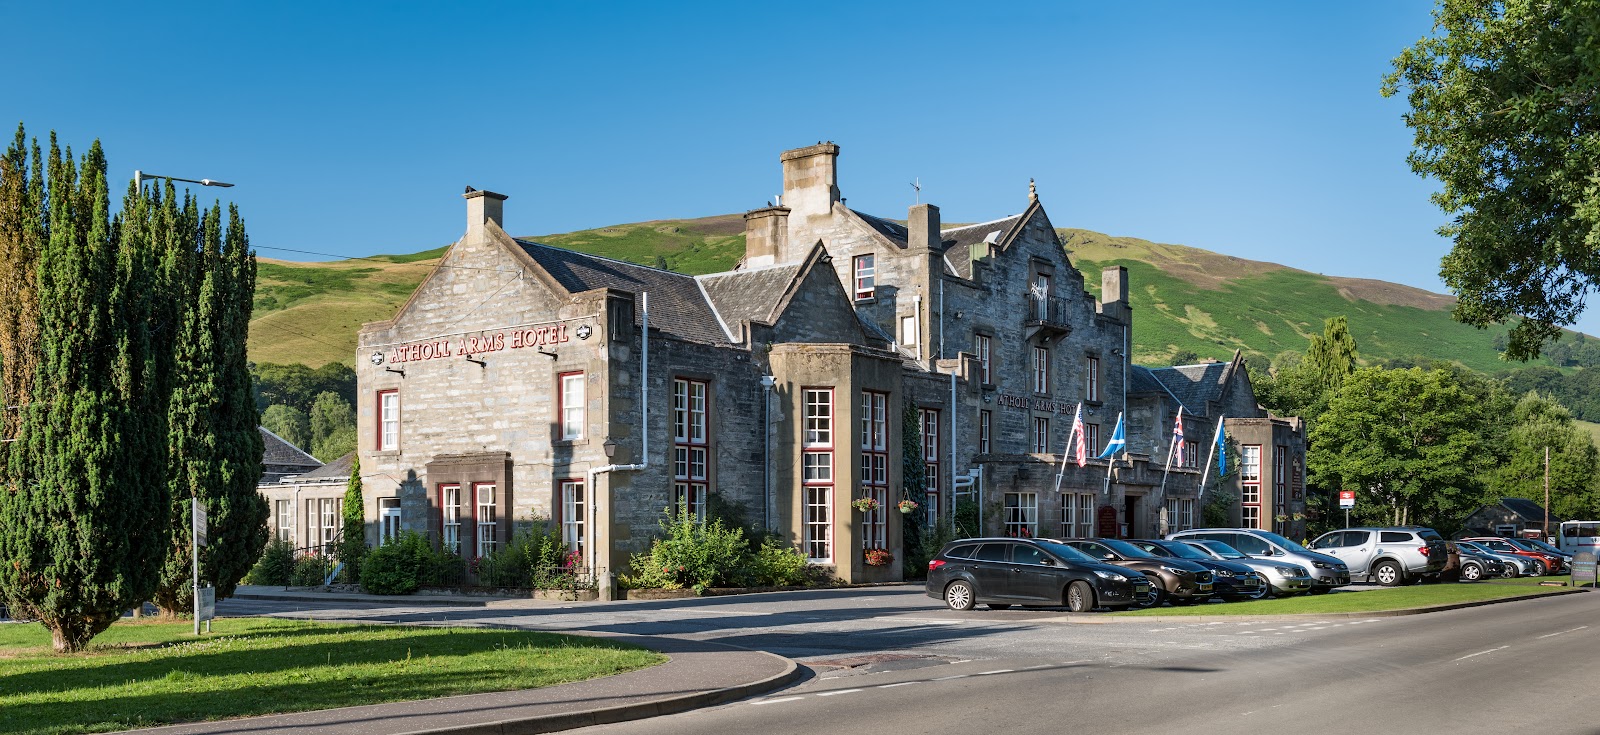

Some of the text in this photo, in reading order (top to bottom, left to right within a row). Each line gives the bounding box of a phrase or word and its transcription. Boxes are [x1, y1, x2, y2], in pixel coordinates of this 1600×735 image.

[389, 324, 569, 364] ATHOLL ARMS HOTEL
[998, 394, 1078, 416] ATHOLL ARMS HOT
